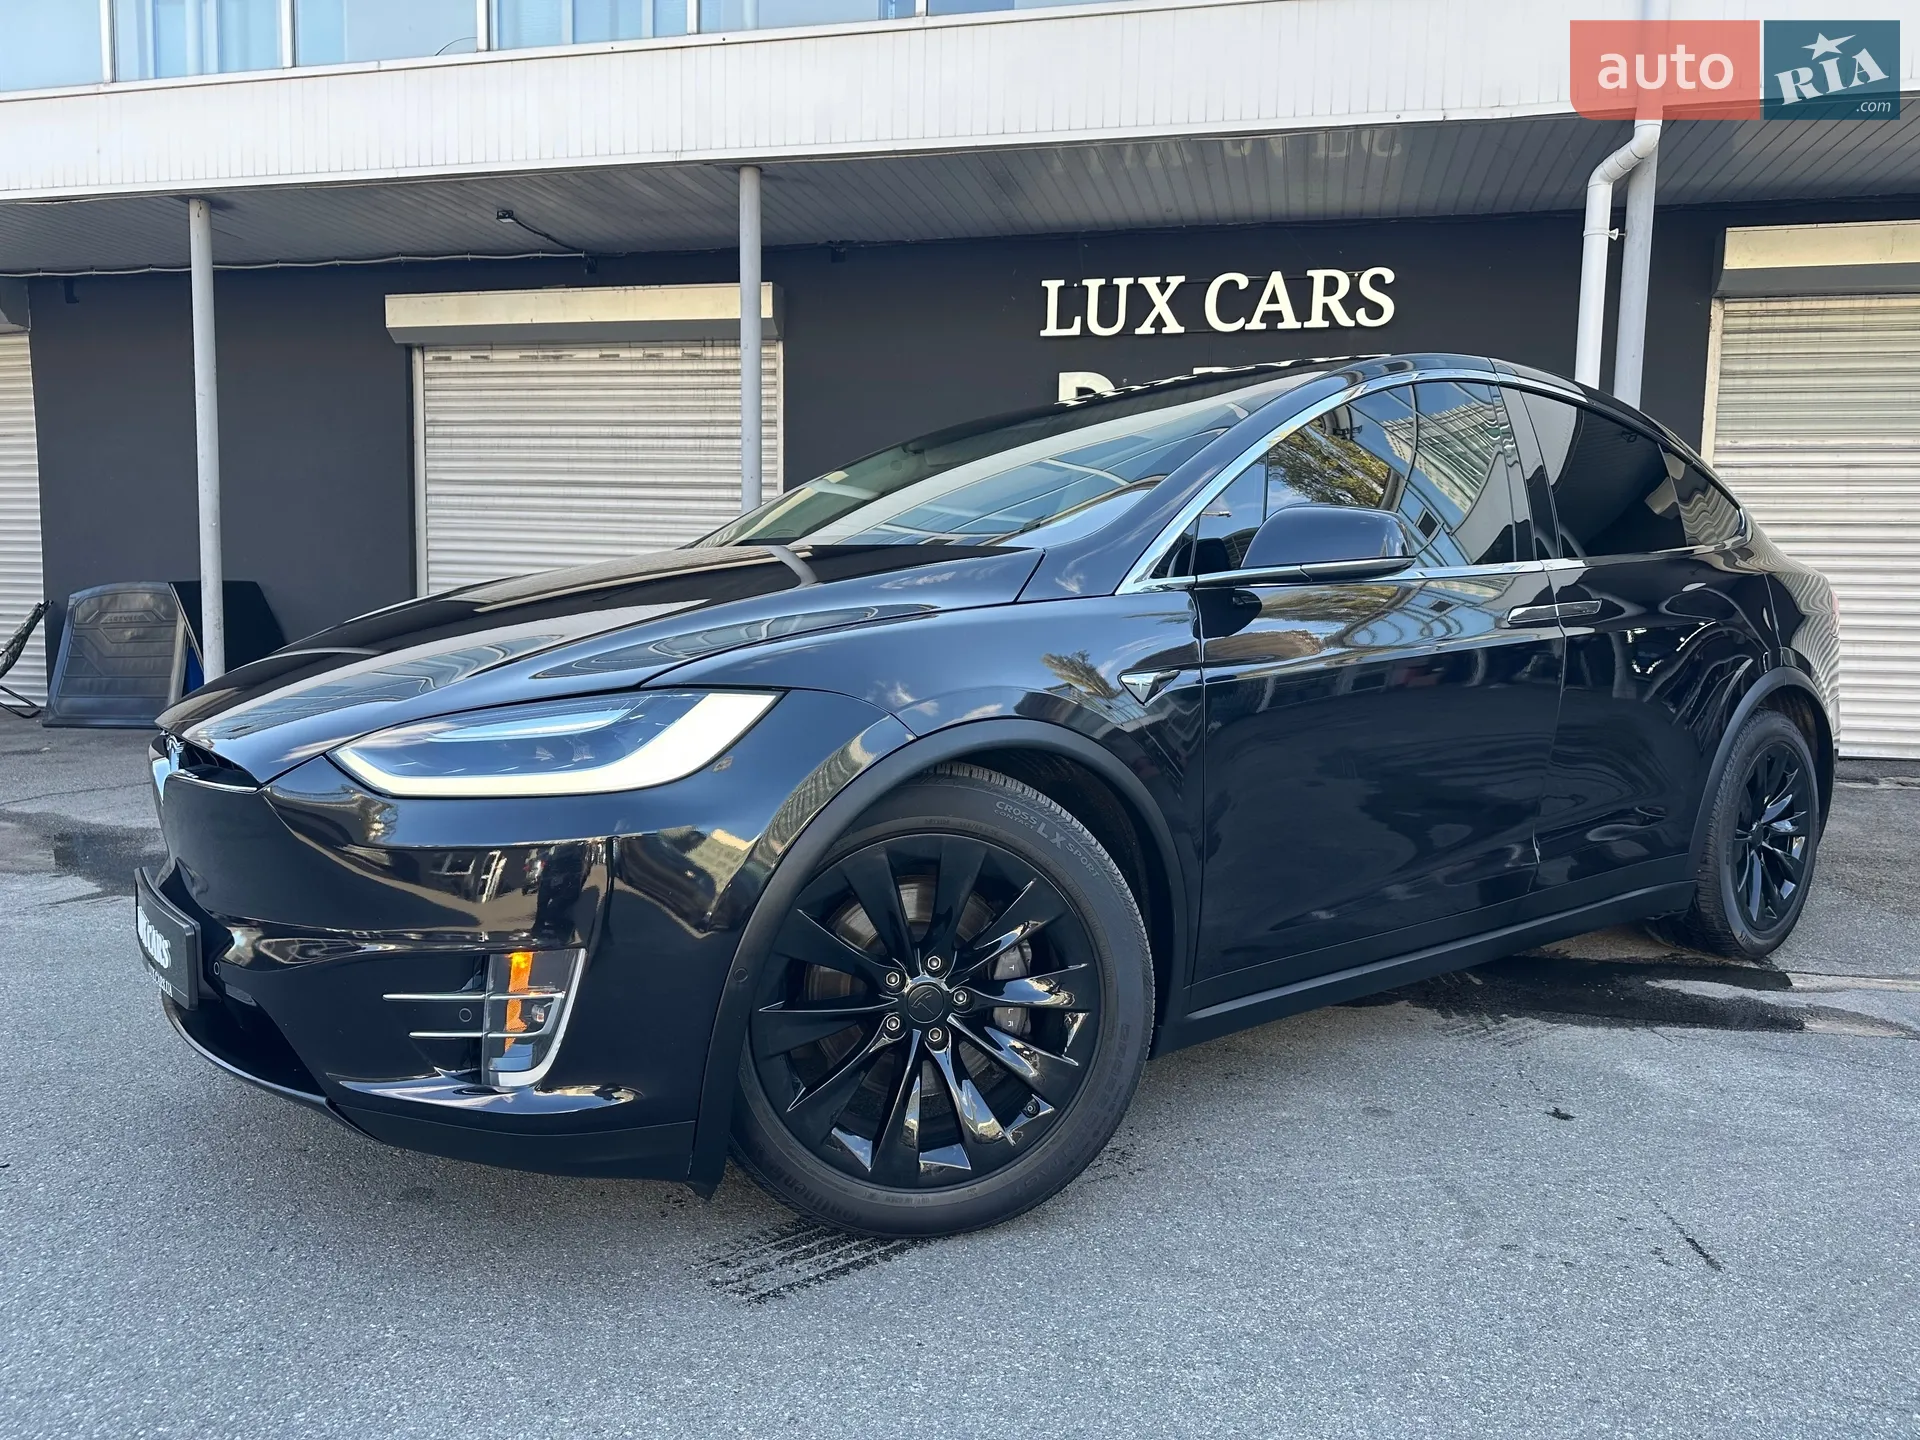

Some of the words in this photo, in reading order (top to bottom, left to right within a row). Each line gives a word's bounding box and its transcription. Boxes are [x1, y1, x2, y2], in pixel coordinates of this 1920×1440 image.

[1039, 275, 1186, 336] LUX
[1203, 266, 1396, 332] CARS
[994, 809, 1034, 830] CONTACT
[995, 801, 1038, 825] CROSS
[1066, 843, 1100, 878] SPORT
